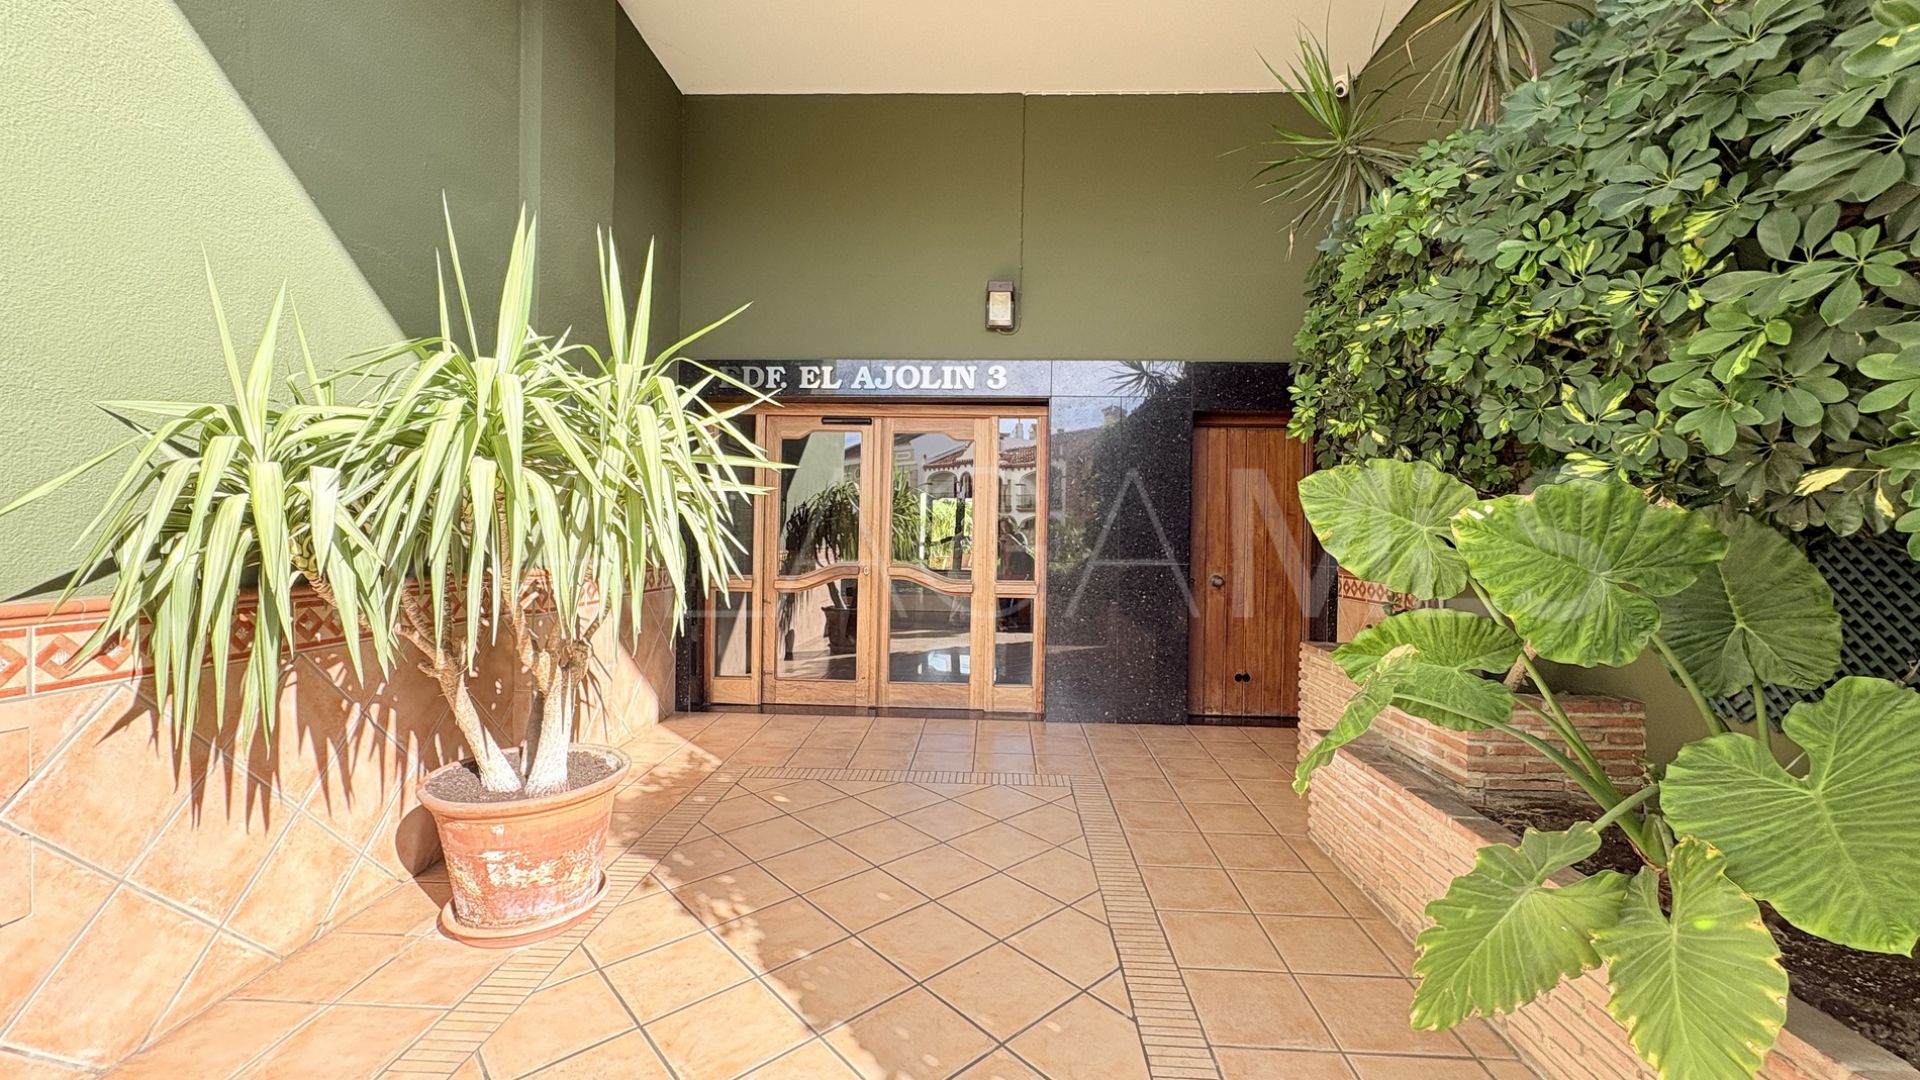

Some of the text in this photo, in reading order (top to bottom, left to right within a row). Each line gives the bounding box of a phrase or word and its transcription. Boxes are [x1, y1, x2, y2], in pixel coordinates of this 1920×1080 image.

[798, 366, 842, 389] EL
[850, 365, 976, 390] AJOLIN
[986, 365, 1008, 389] 3
